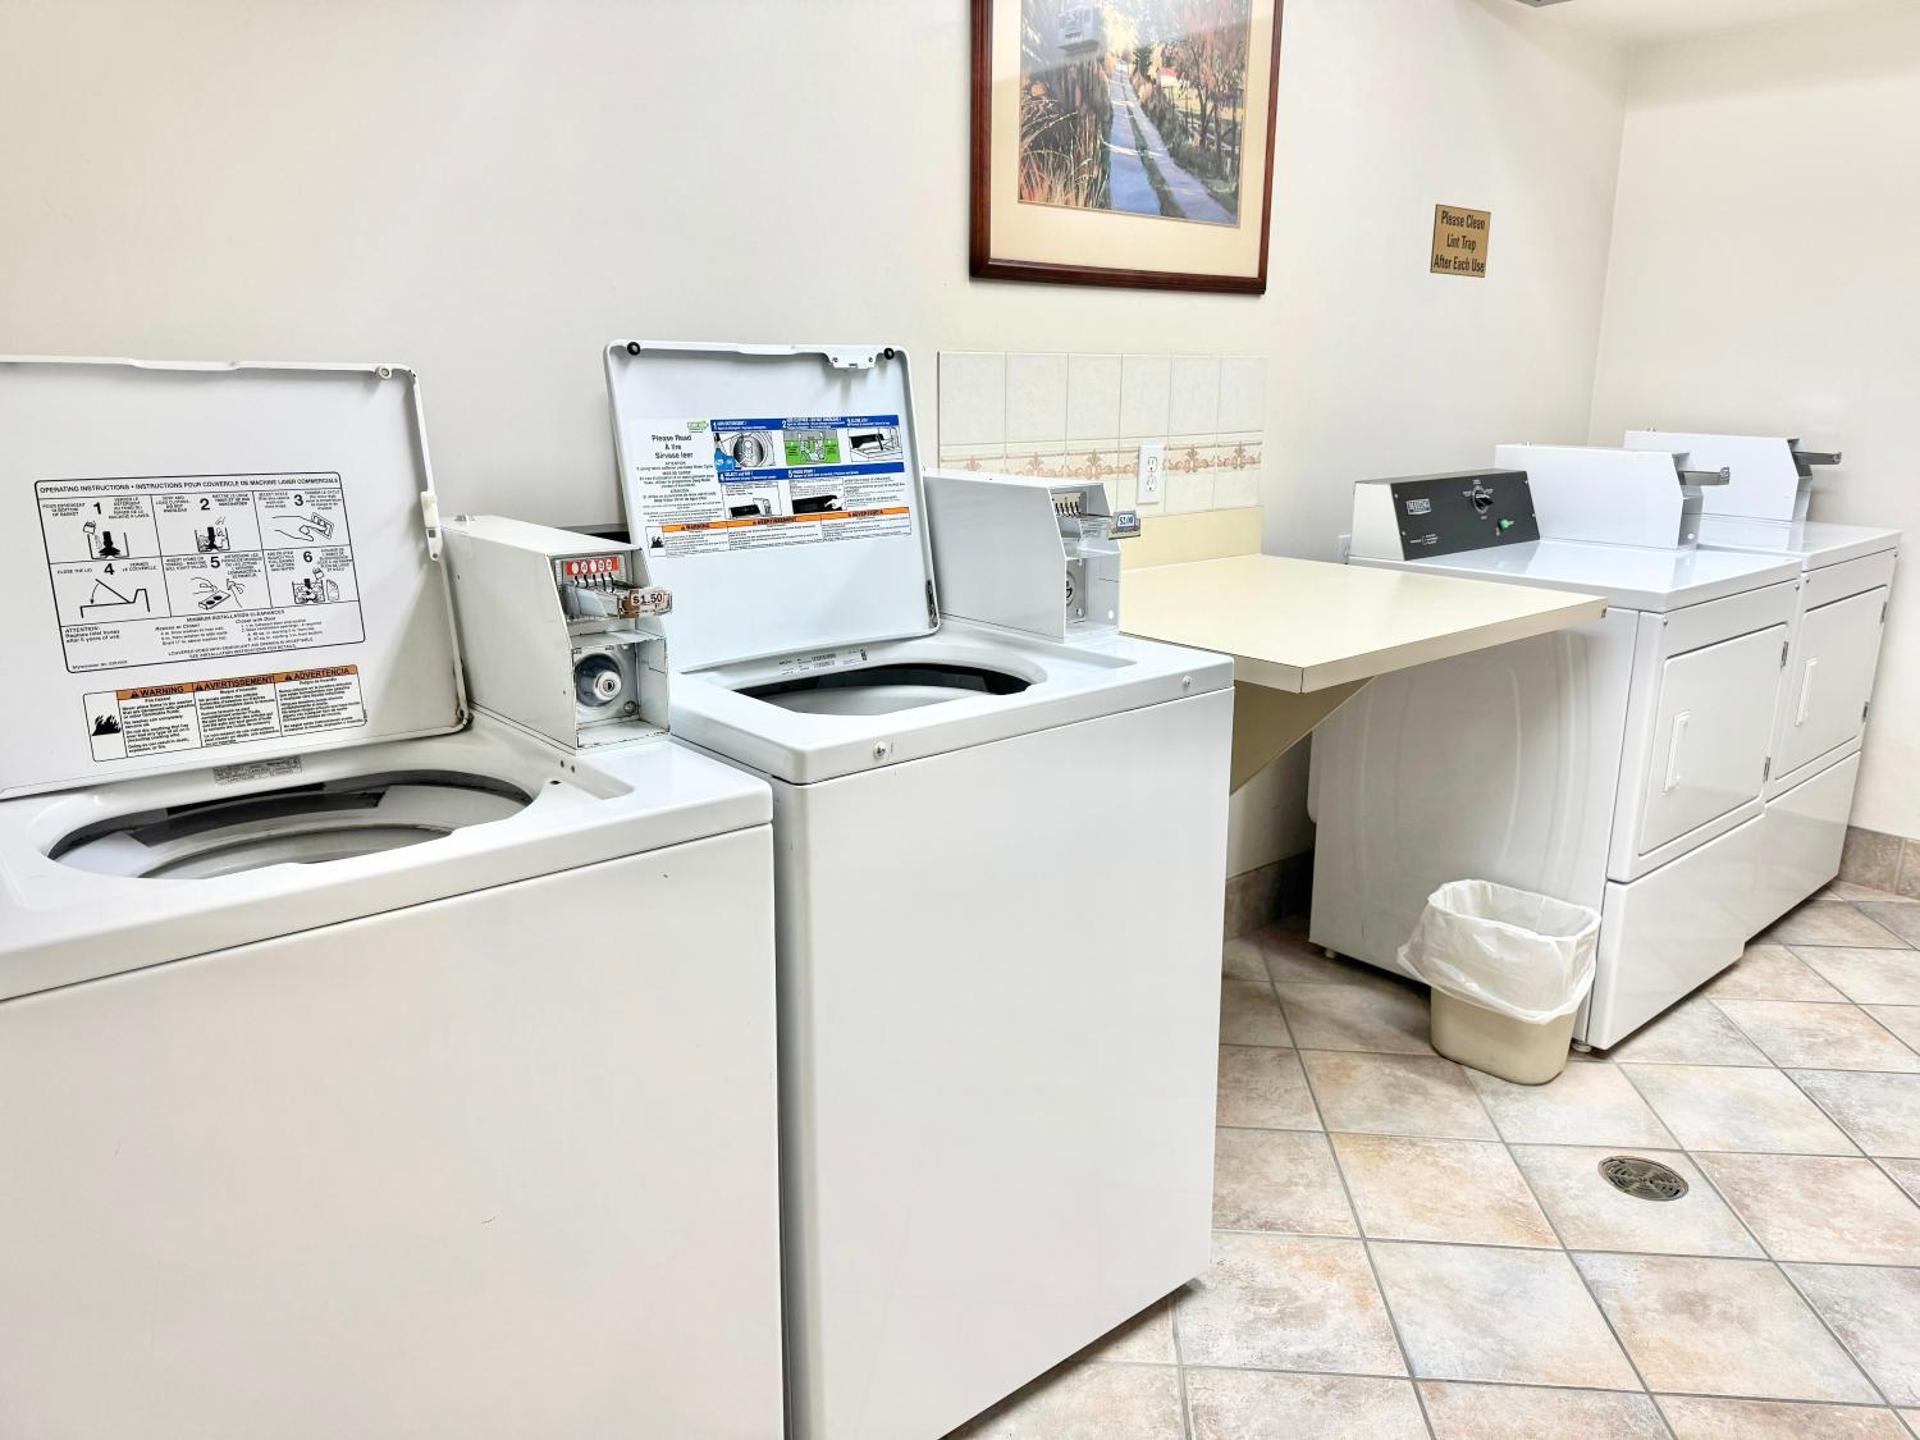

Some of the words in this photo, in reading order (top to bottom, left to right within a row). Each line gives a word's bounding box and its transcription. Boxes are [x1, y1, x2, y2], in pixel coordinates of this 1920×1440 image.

[1441, 210, 1464, 227] Please
[1466, 214, 1486, 230] Clean
[1447, 233, 1460, 248] Lint
[1461, 235, 1477, 253] Trap
[1433, 254, 1452, 269] After
[1453, 256, 1470, 271] Each
[1471, 258, 1486, 273] Use
[651, 434, 674, 443] Please
[675, 434, 692, 442] Read
[40, 485, 79, 494] OPERATING
[80, 484, 130, 493] INSTRUCTIONS
[135, 483, 183, 491] INSTRUCTIONS
[199, 498, 210, 511] 2
[294, 494, 304, 507] 3
[93, 502, 102, 515] 1
[210, 556, 221, 569] 5
[303, 551, 313, 563] 6
[104, 563, 115, 575] 4
[633, 593, 663, 606] $1.50
[294, 668, 351, 680] ADVERTENCIA
[204, 675, 274, 691] AVERTISSEMENT
[140, 686, 185, 698] WARNING
